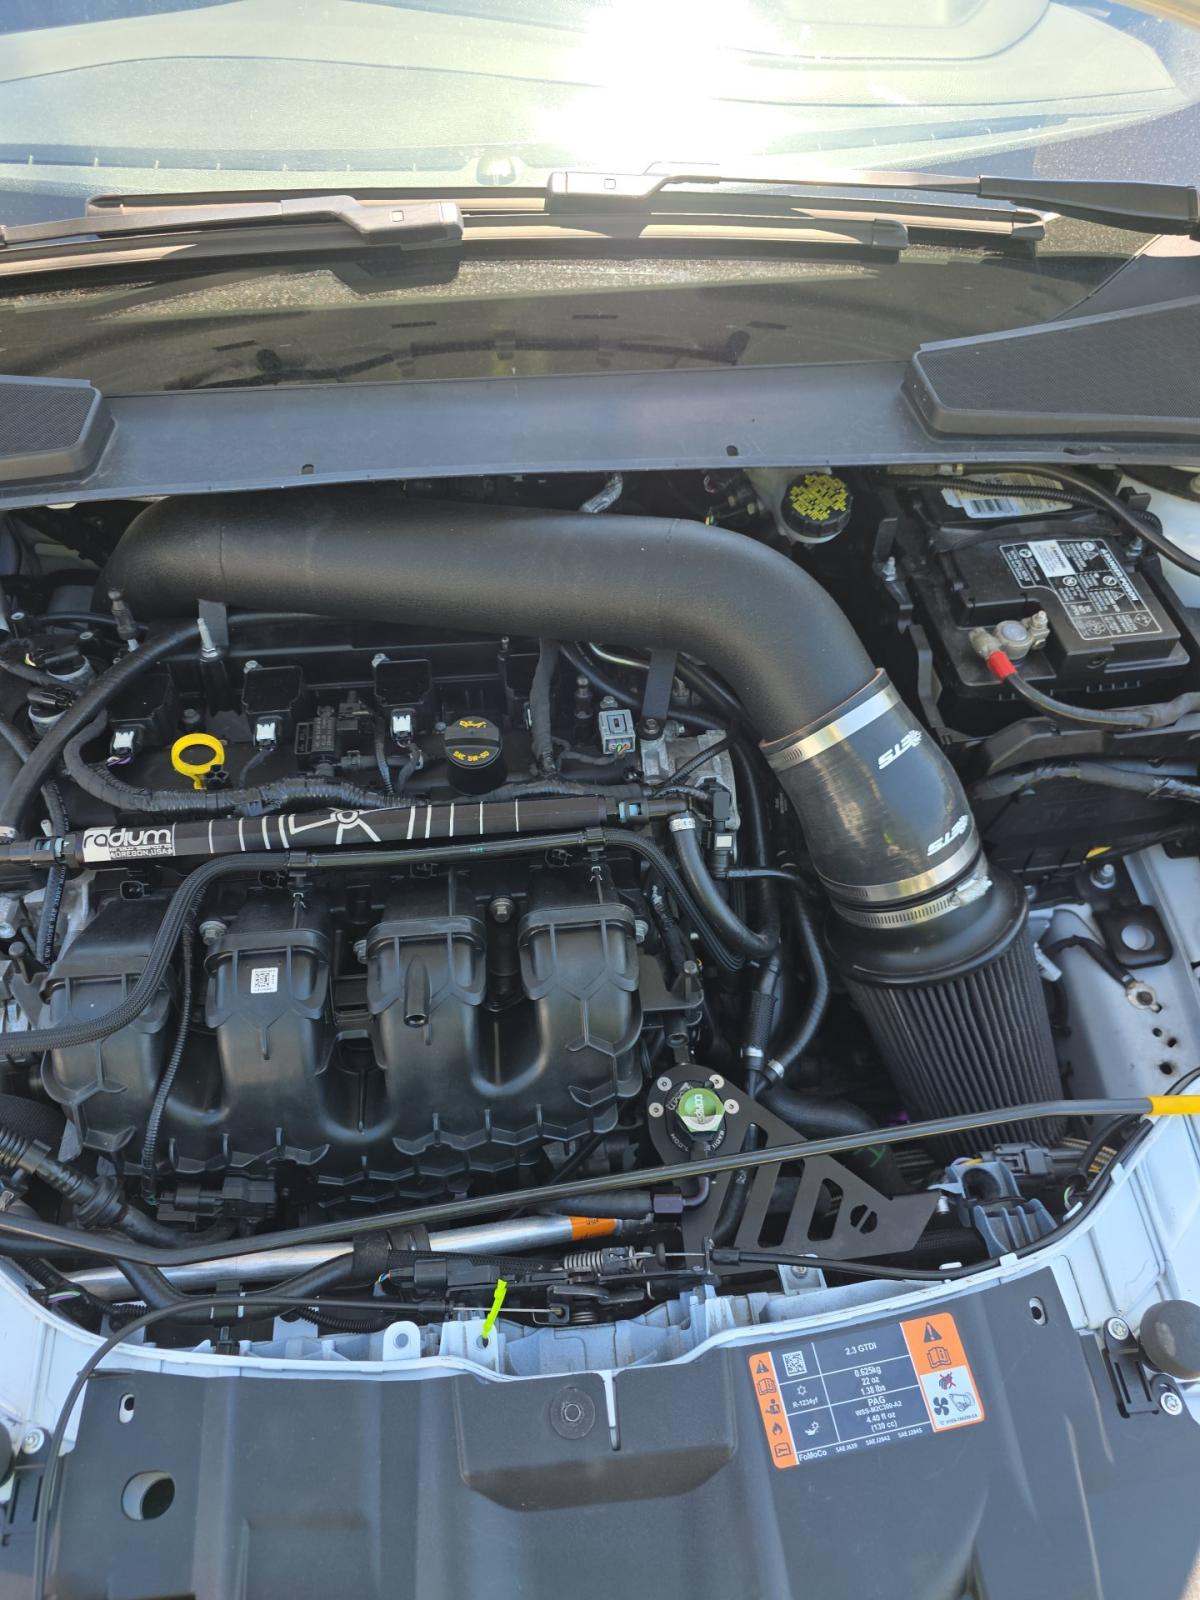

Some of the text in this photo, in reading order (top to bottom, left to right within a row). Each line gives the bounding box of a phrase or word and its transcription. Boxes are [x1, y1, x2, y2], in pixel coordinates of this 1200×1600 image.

[83, 828, 171, 848] radium
[844, 1346, 857, 1356] 2.3
[854, 1366, 882, 1378] 0.625kg
[861, 1376, 880, 1386] 22 oz
[861, 1384, 886, 1395] 1.38 lbs
[867, 1396, 886, 1407] PAG
[887, 1411, 896, 1419] oz
[886, 1419, 898, 1429] cc)
[798, 1449, 828, 1462] FoMoCo
